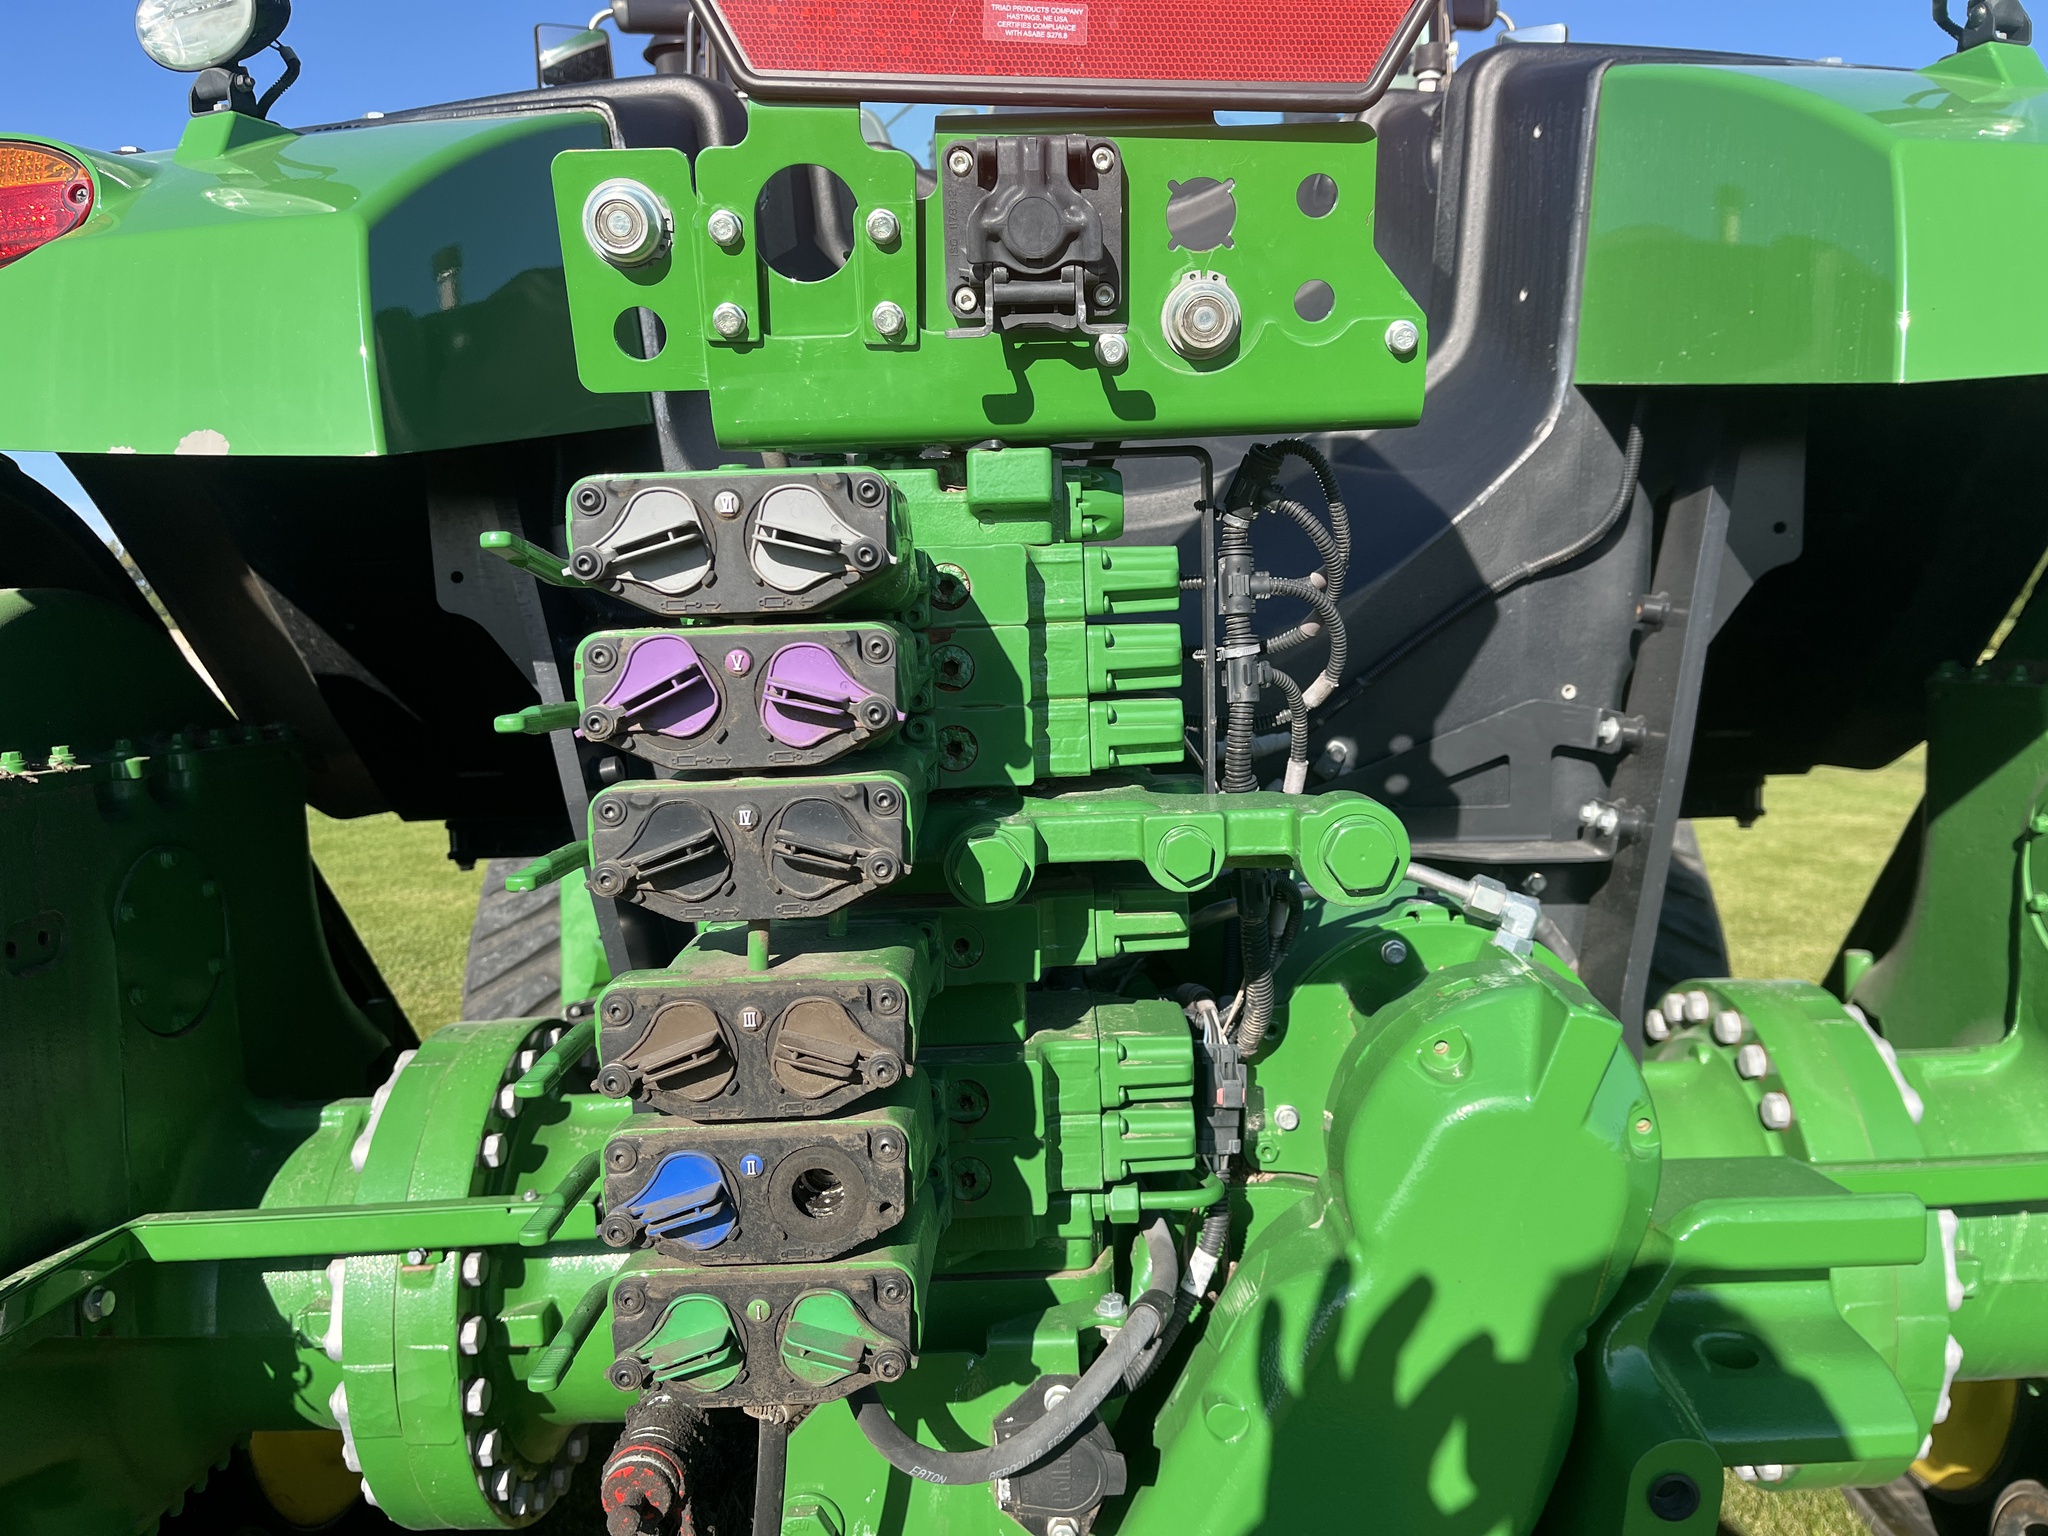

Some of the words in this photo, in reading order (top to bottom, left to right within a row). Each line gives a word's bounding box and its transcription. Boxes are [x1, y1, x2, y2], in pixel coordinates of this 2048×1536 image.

[1006, 13, 1041, 21] HASTINGS,
[1012, 5, 1049, 13] PRODUCTS
[1050, 7, 1084, 15] COMPANY
[997, 20, 1031, 28] CERTIFIES
[1033, 22, 1076, 31] COMPLIANCE
[1005, 29, 1022, 37] WITH
[719, 496, 733, 513] VI
[730, 654, 744, 671] V
[739, 810, 752, 826] IV
[743, 1012, 757, 1029] III
[746, 1160, 757, 1176] II
[909, 1465, 948, 1484] EATON
